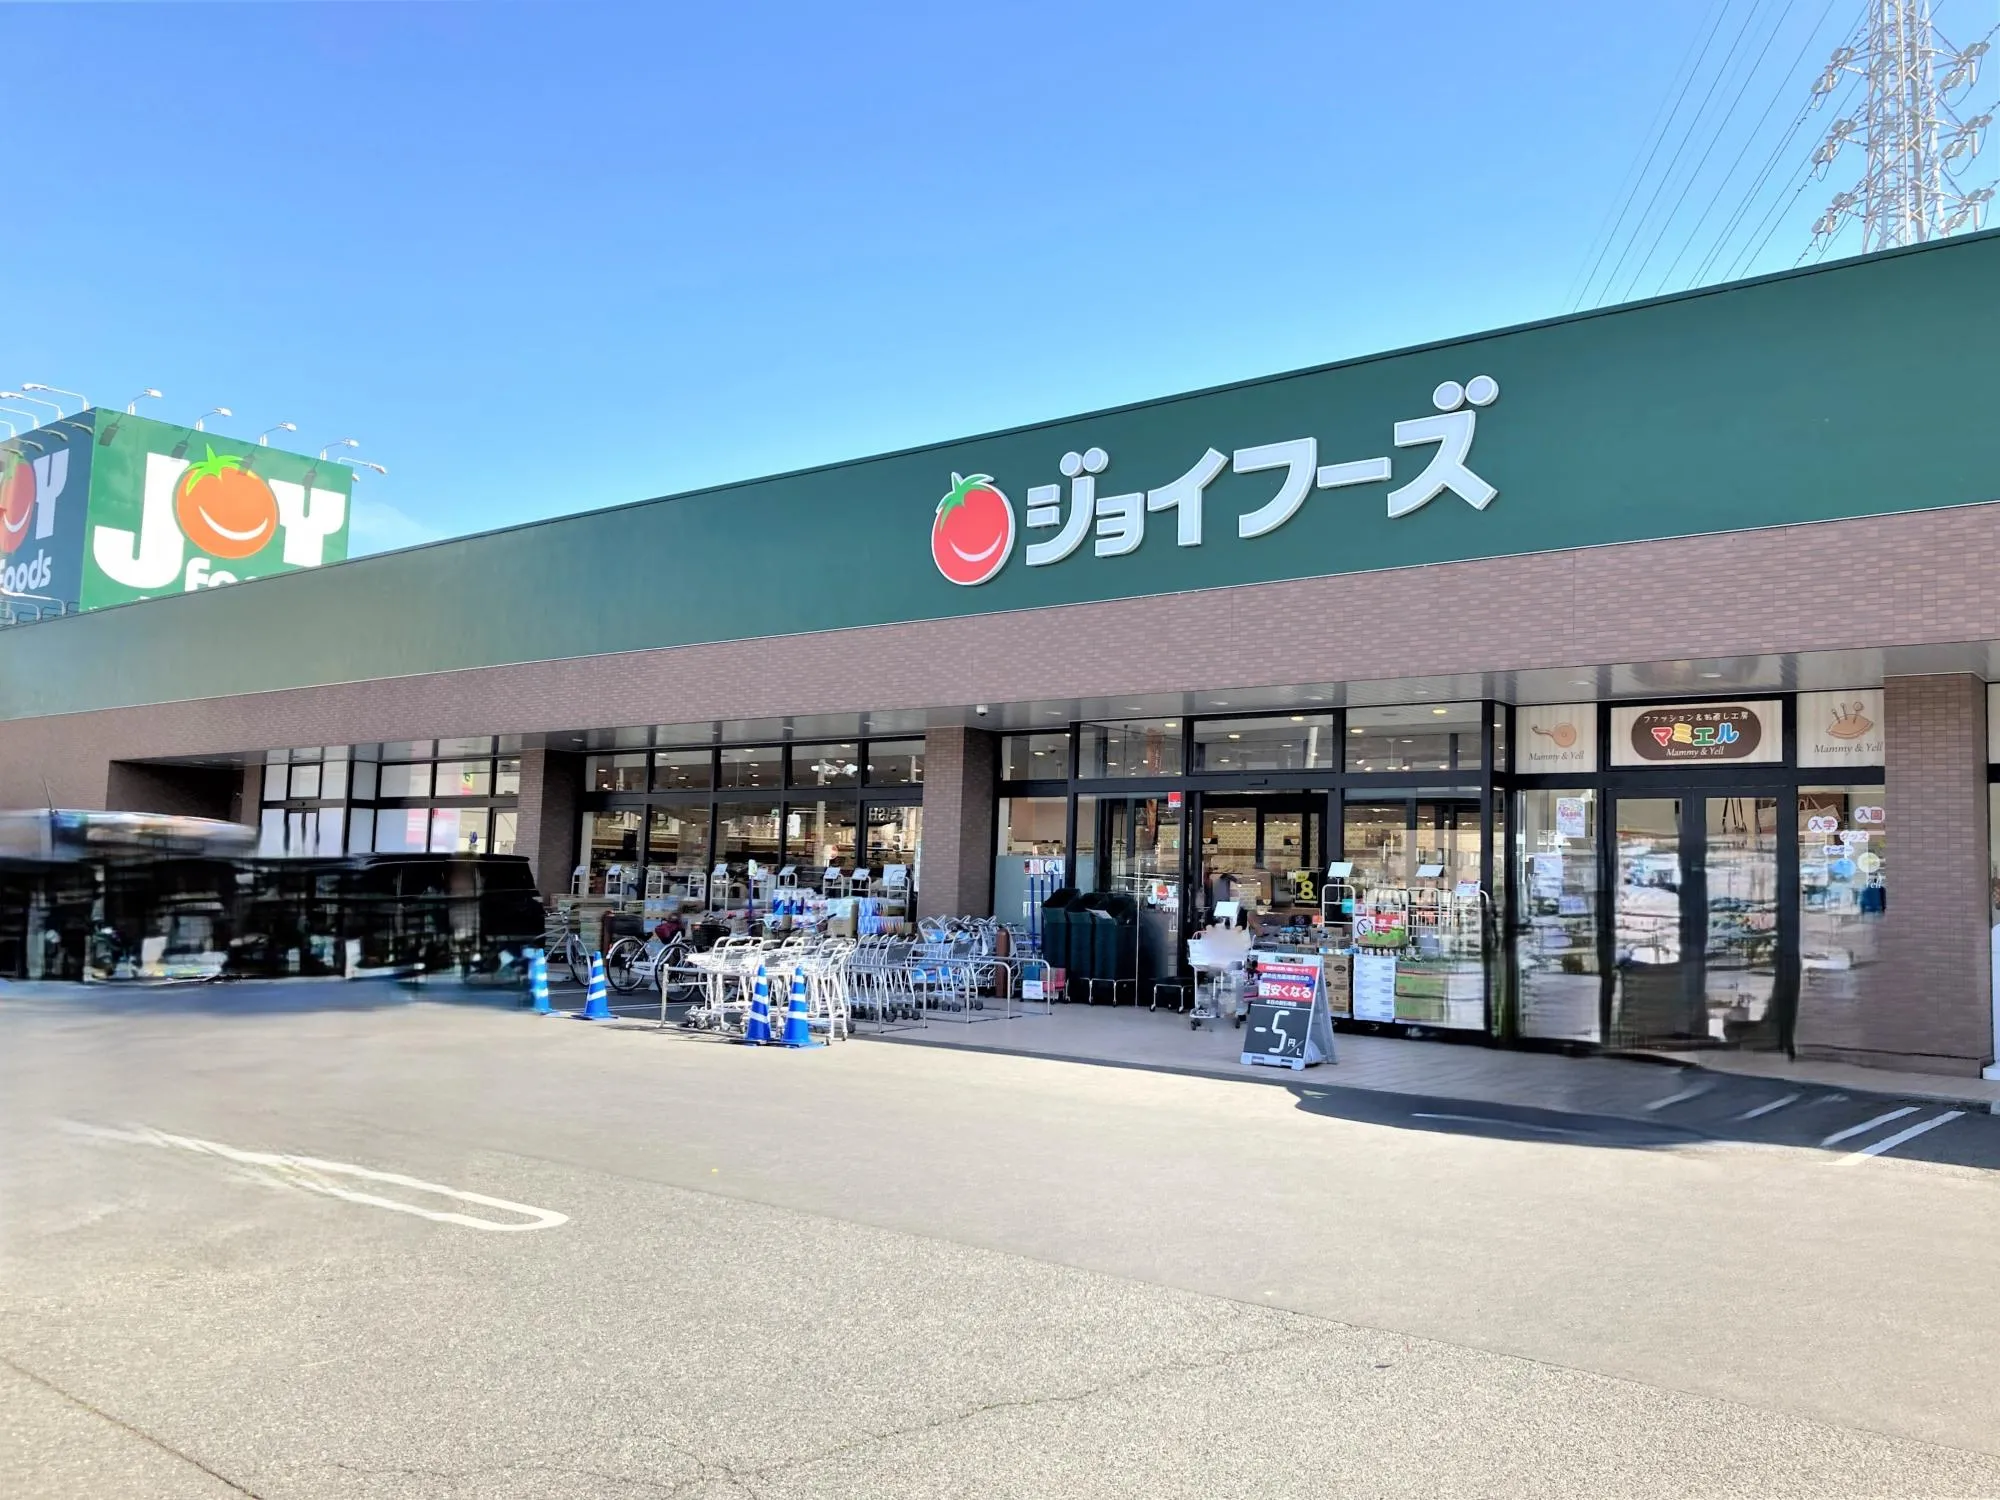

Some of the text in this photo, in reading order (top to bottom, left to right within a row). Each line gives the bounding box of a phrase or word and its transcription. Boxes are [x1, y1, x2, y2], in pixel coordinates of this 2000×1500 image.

[1025, 375, 1499, 566] ジョイフーズ
[93, 451, 347, 589] JOY
[1651, 722, 1740, 747] マミエル
[1528, 750, 1585, 763] Mammy & Yell
[1666, 746, 1724, 758] Mammy & Yell
[1814, 740, 1884, 756] Mammy & Yell
